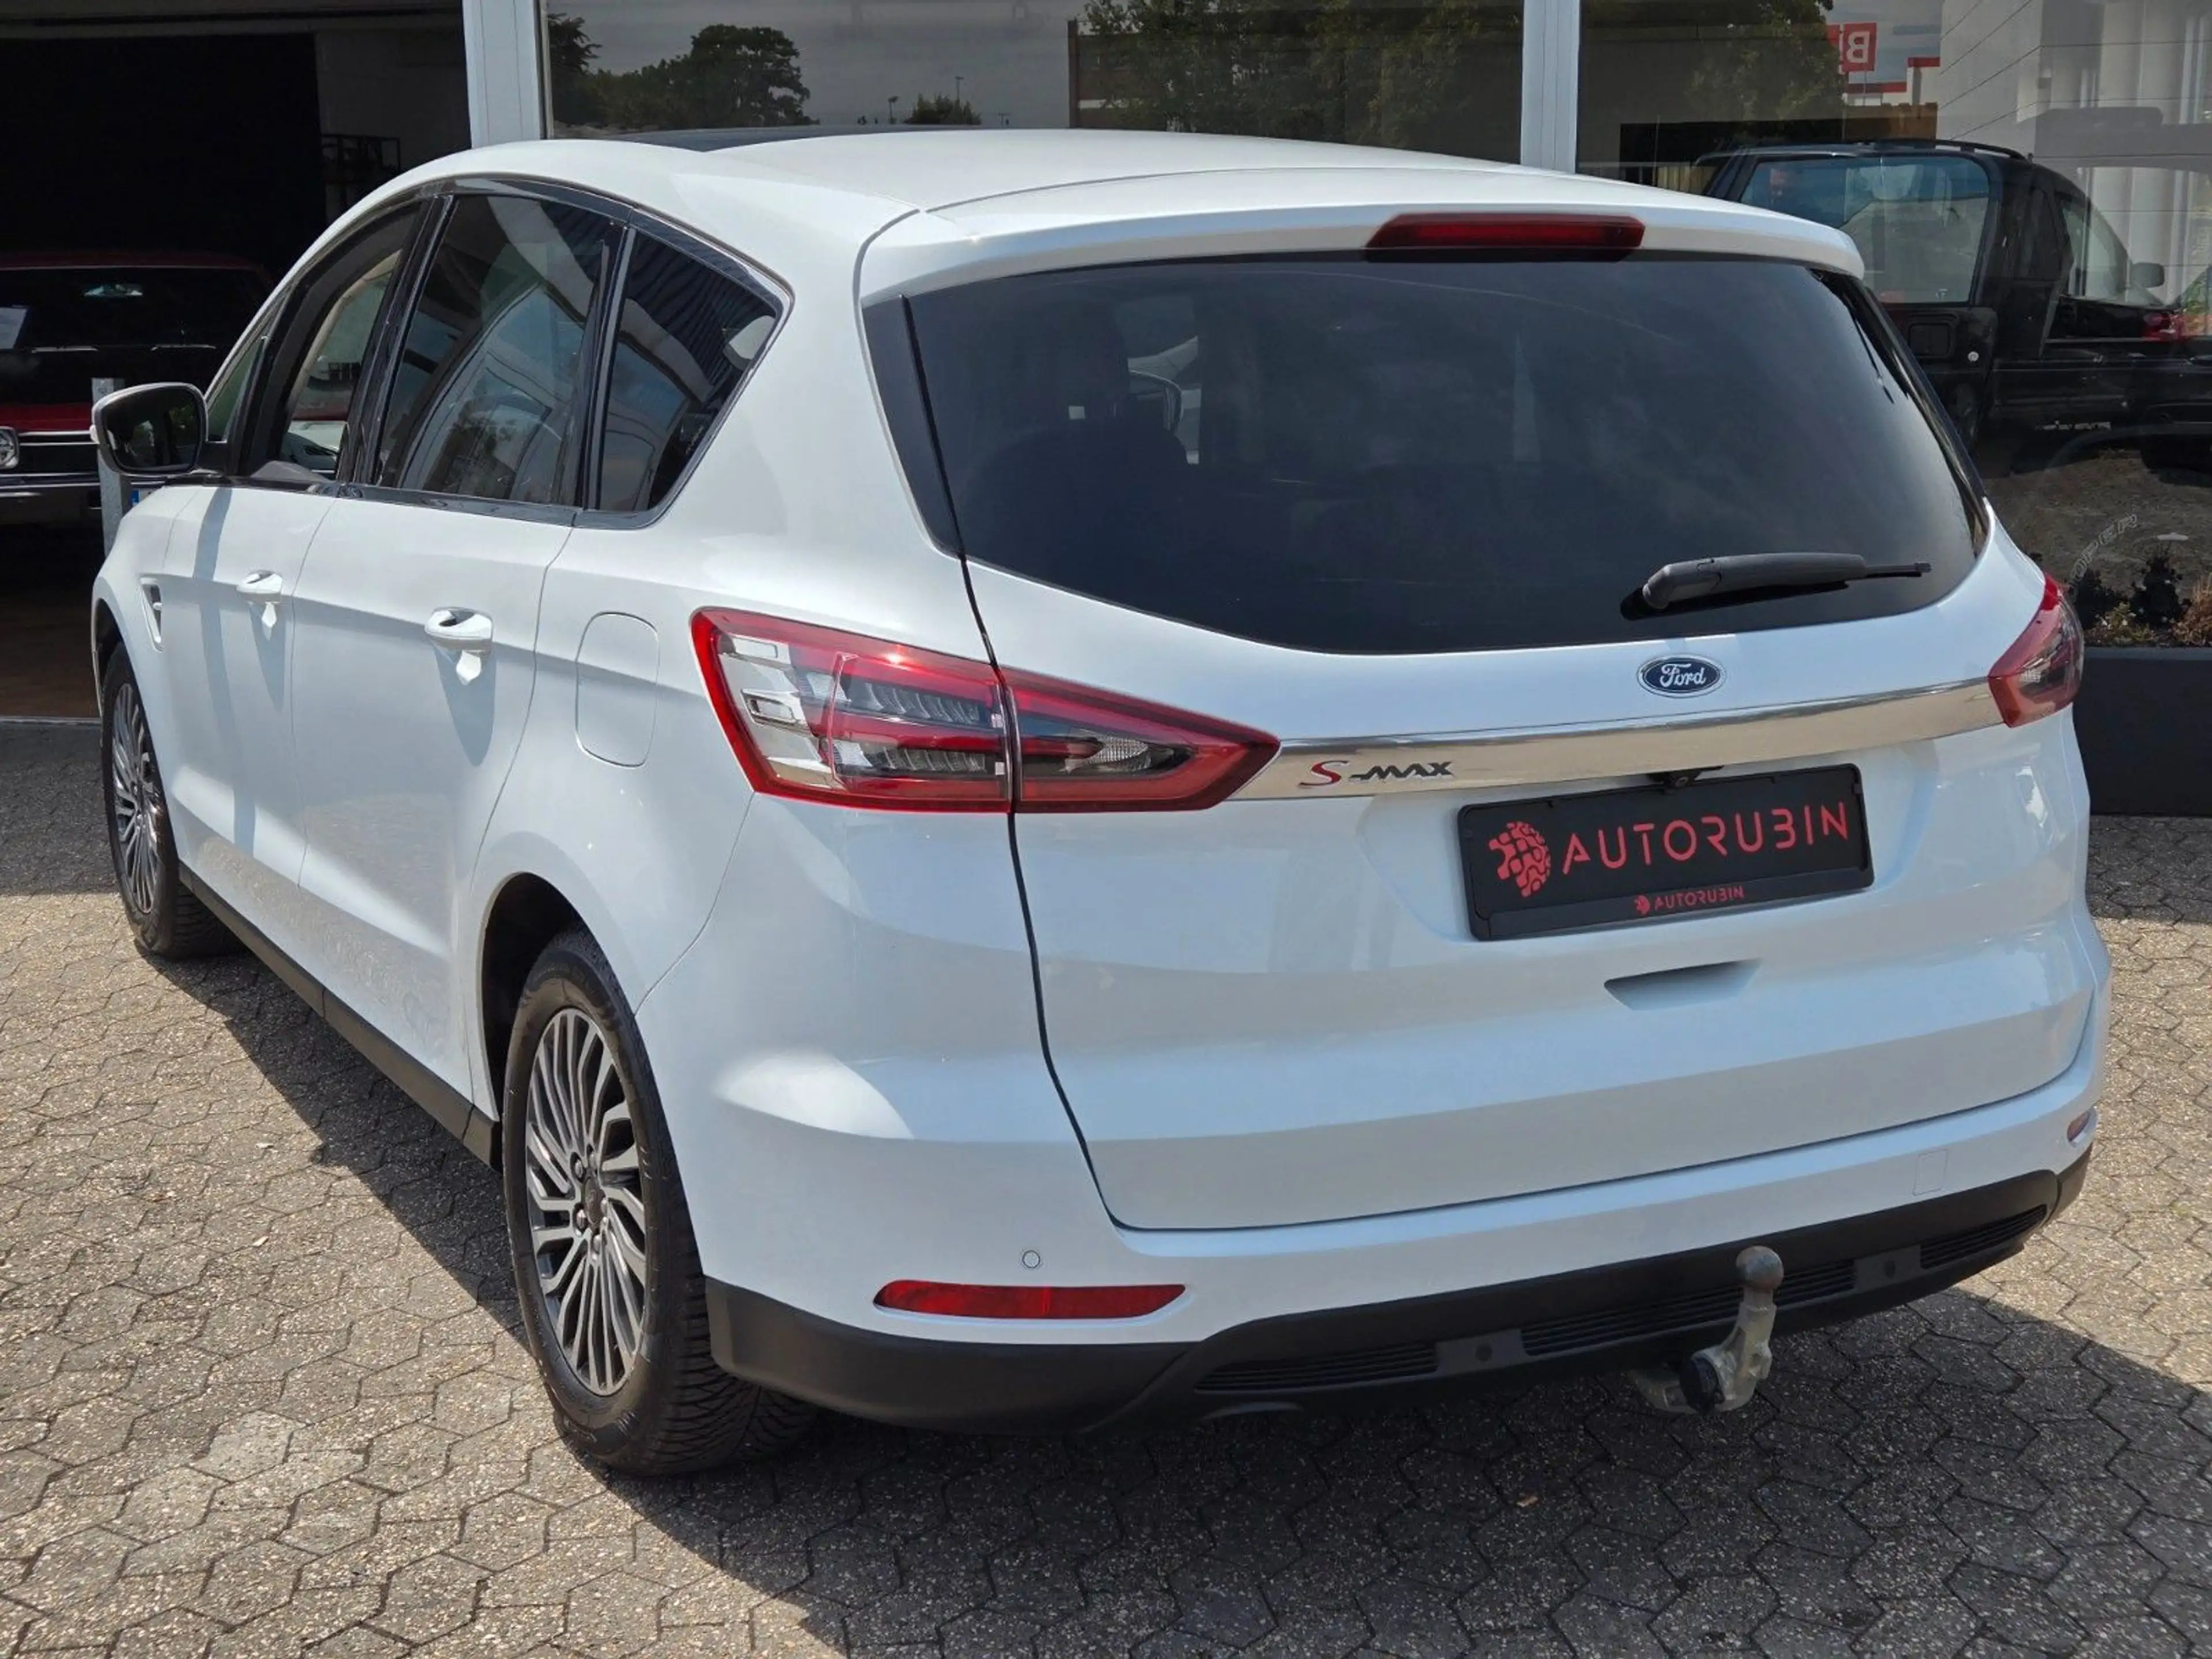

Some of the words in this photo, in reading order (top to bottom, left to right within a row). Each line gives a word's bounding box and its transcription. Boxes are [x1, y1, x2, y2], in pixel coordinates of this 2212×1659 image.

[1660, 664, 1707, 687] Ford
[1563, 802, 1847, 875] AUTORUBIN
[1654, 885, 1744, 911] AUTORUBIN
